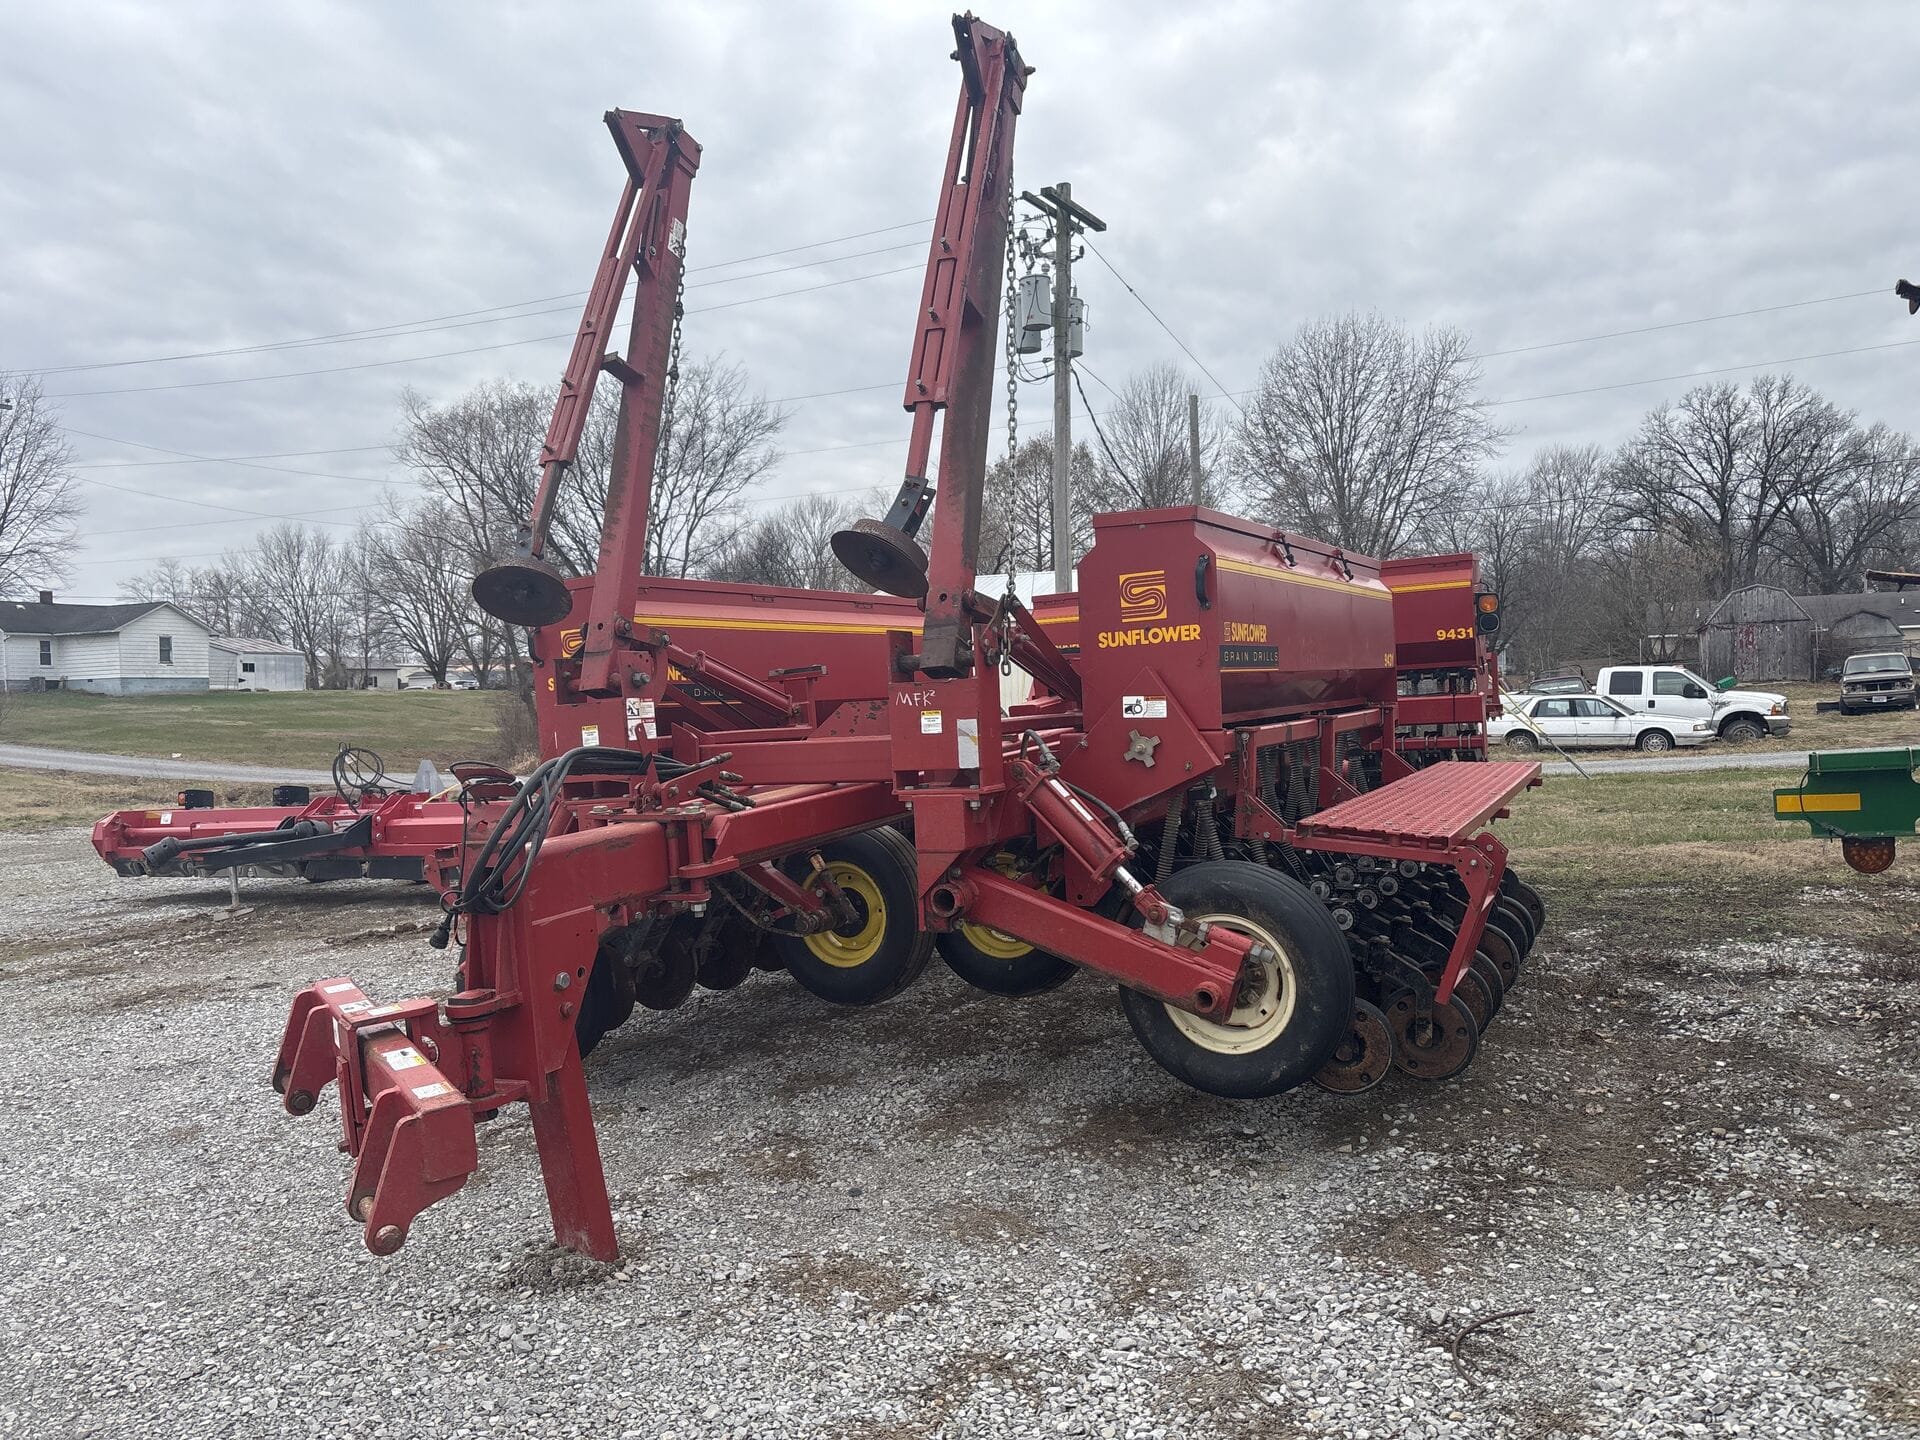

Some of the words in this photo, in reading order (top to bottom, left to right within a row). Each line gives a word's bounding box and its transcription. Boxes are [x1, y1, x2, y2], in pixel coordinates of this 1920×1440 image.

[1098, 624, 1201, 649] SUNFLOWER
[1231, 622, 1267, 643] SUNFLOWER
[1436, 627, 1474, 640] 9431
[1224, 650, 1249, 662] GRAIN
[1253, 651, 1279, 662] DRILLS
